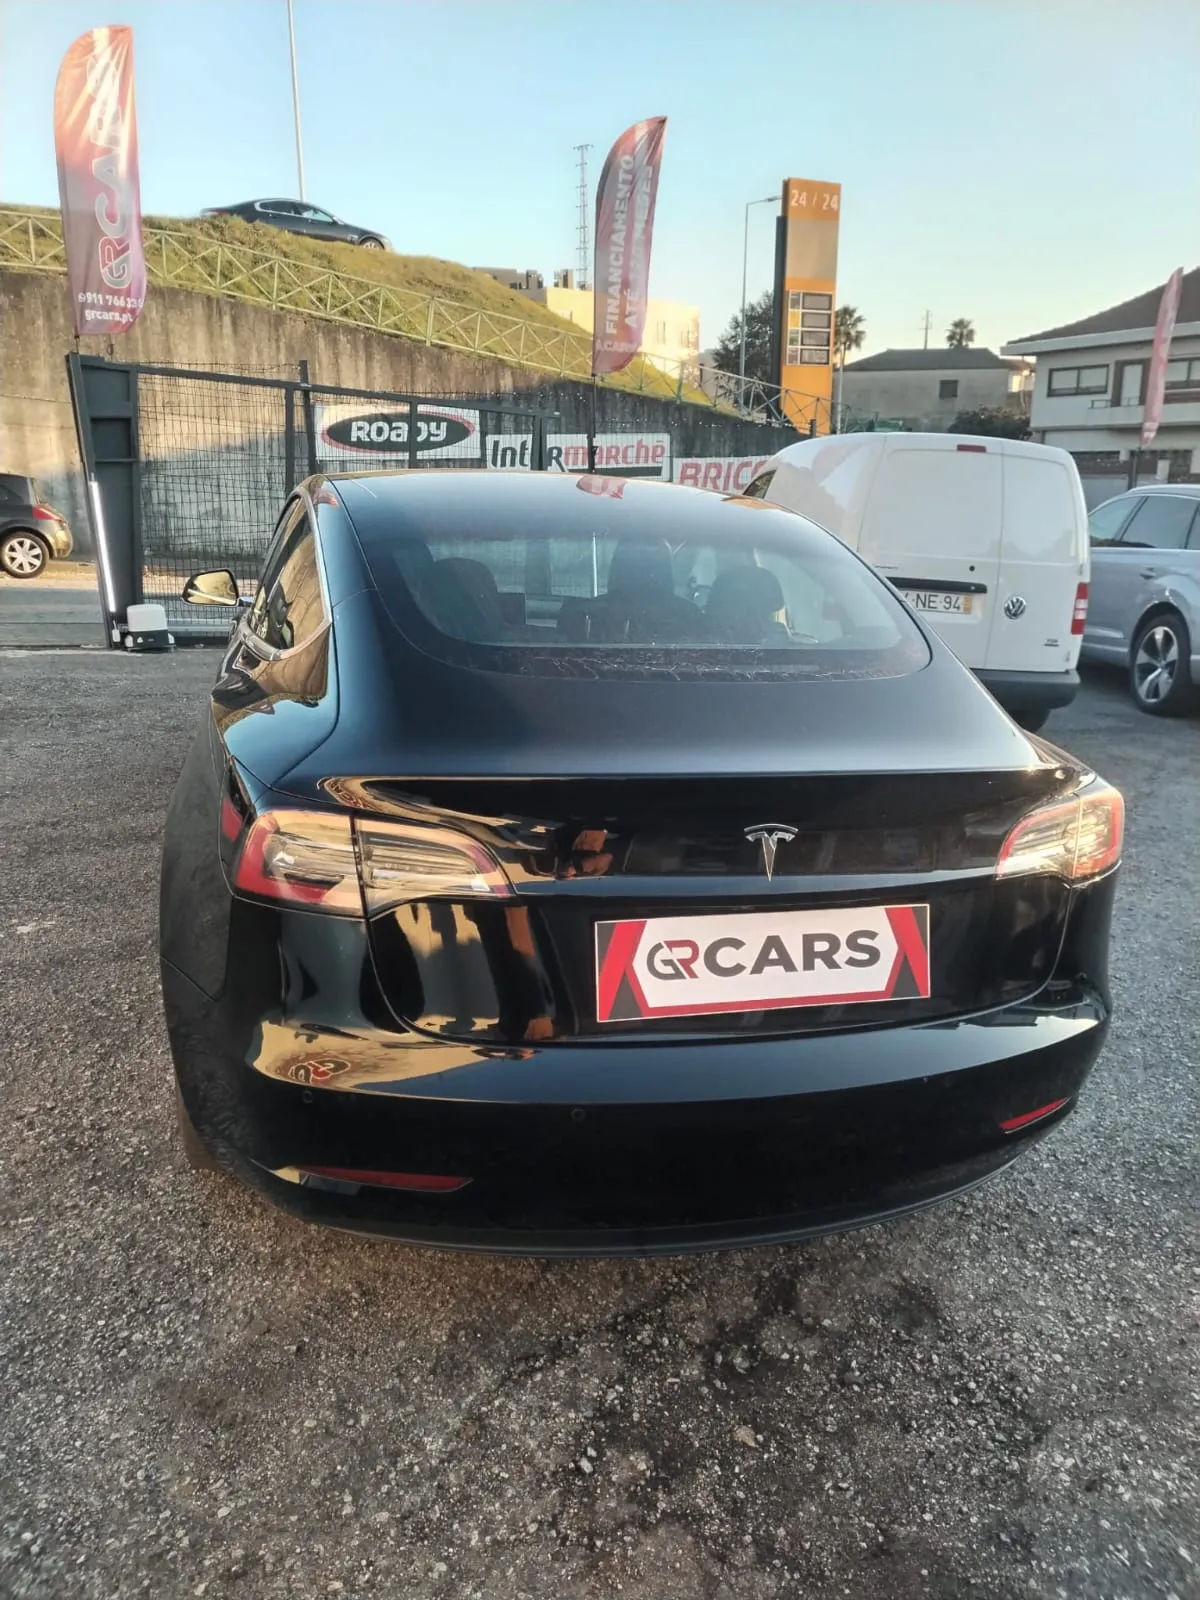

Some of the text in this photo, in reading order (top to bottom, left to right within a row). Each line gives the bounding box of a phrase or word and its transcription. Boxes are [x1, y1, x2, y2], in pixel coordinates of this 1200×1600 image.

[791, 189, 807, 207] 24
[822, 193, 839, 211] 24
[605, 155, 634, 334] FINANCIAMENTO
[624, 288, 638, 328] ATÉ
[647, 929, 881, 981] GRCARS
